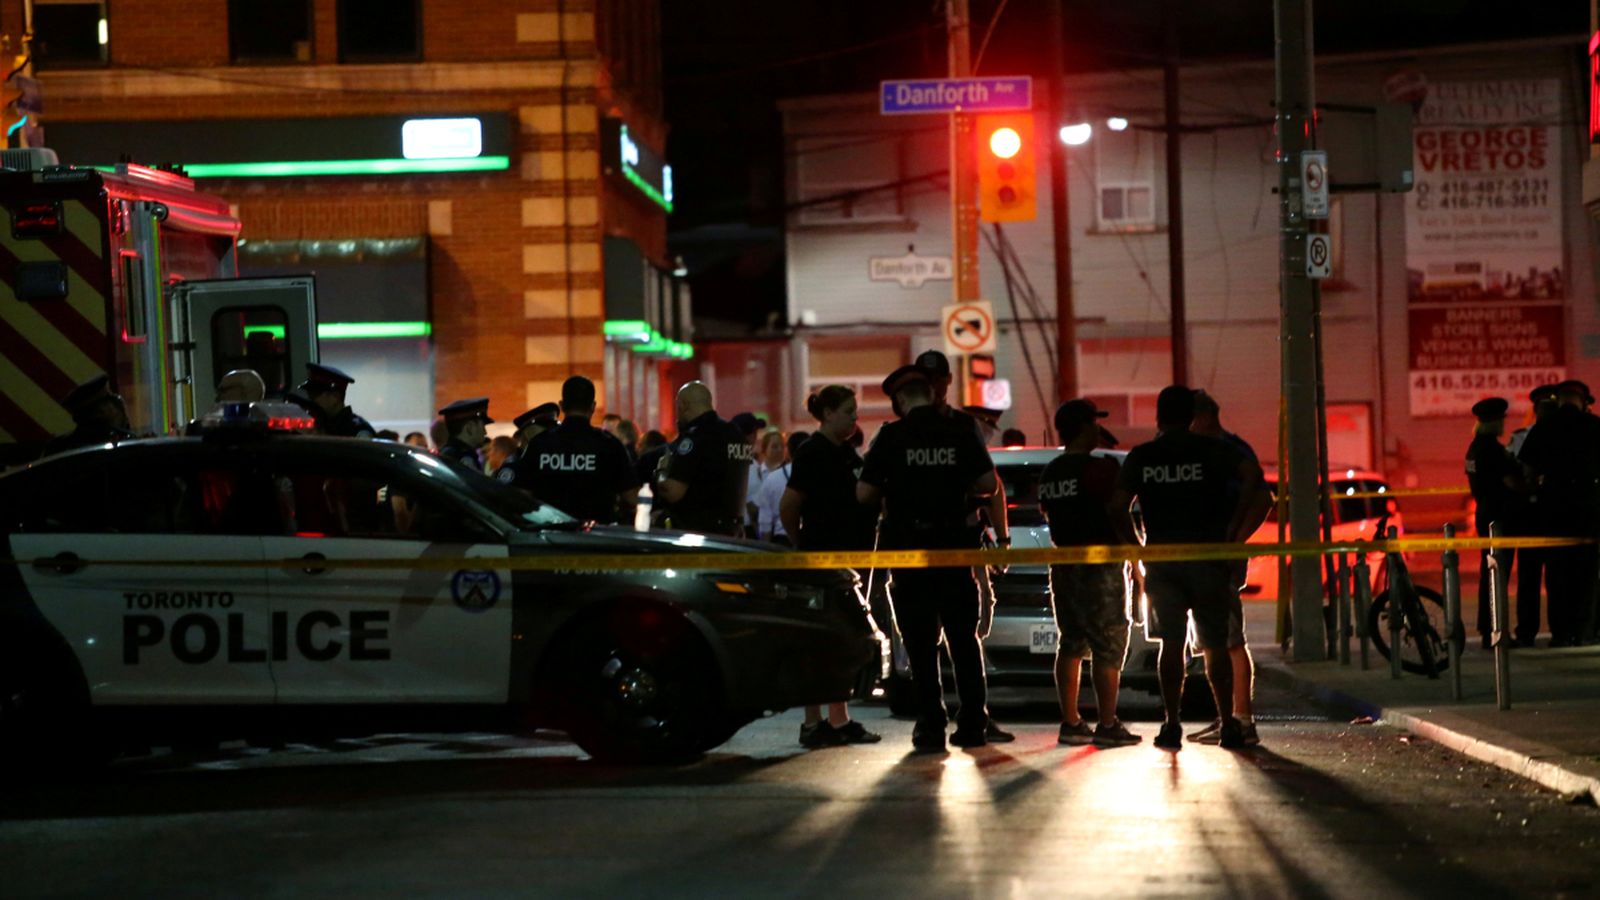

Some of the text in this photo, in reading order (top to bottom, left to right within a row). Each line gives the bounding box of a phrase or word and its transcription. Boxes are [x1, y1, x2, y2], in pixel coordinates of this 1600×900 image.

[896, 82, 1015, 105] Danforth Ave
[1424, 101, 1505, 119] REALTY
[1415, 127, 1548, 151] GEORGE
[1418, 150, 1545, 172] VRETOS
[875, 261, 928, 275] Danforth
[1446, 309, 1522, 322] BANNERS
[1432, 322, 1538, 337] STORE SIGNS
[1421, 337, 1549, 352] VEHICLE WRAPS
[1416, 352, 1554, 367] BUSINESS CARDS
[1415, 372, 1559, 389] 416.525.5850
[539, 453, 597, 471] POLICE
[905, 447, 957, 467] POLICE
[1142, 463, 1203, 484] POLICE
[1037, 478, 1079, 501] POLICE
[123, 591, 234, 609] TORONTO
[123, 610, 391, 665] POLICE
